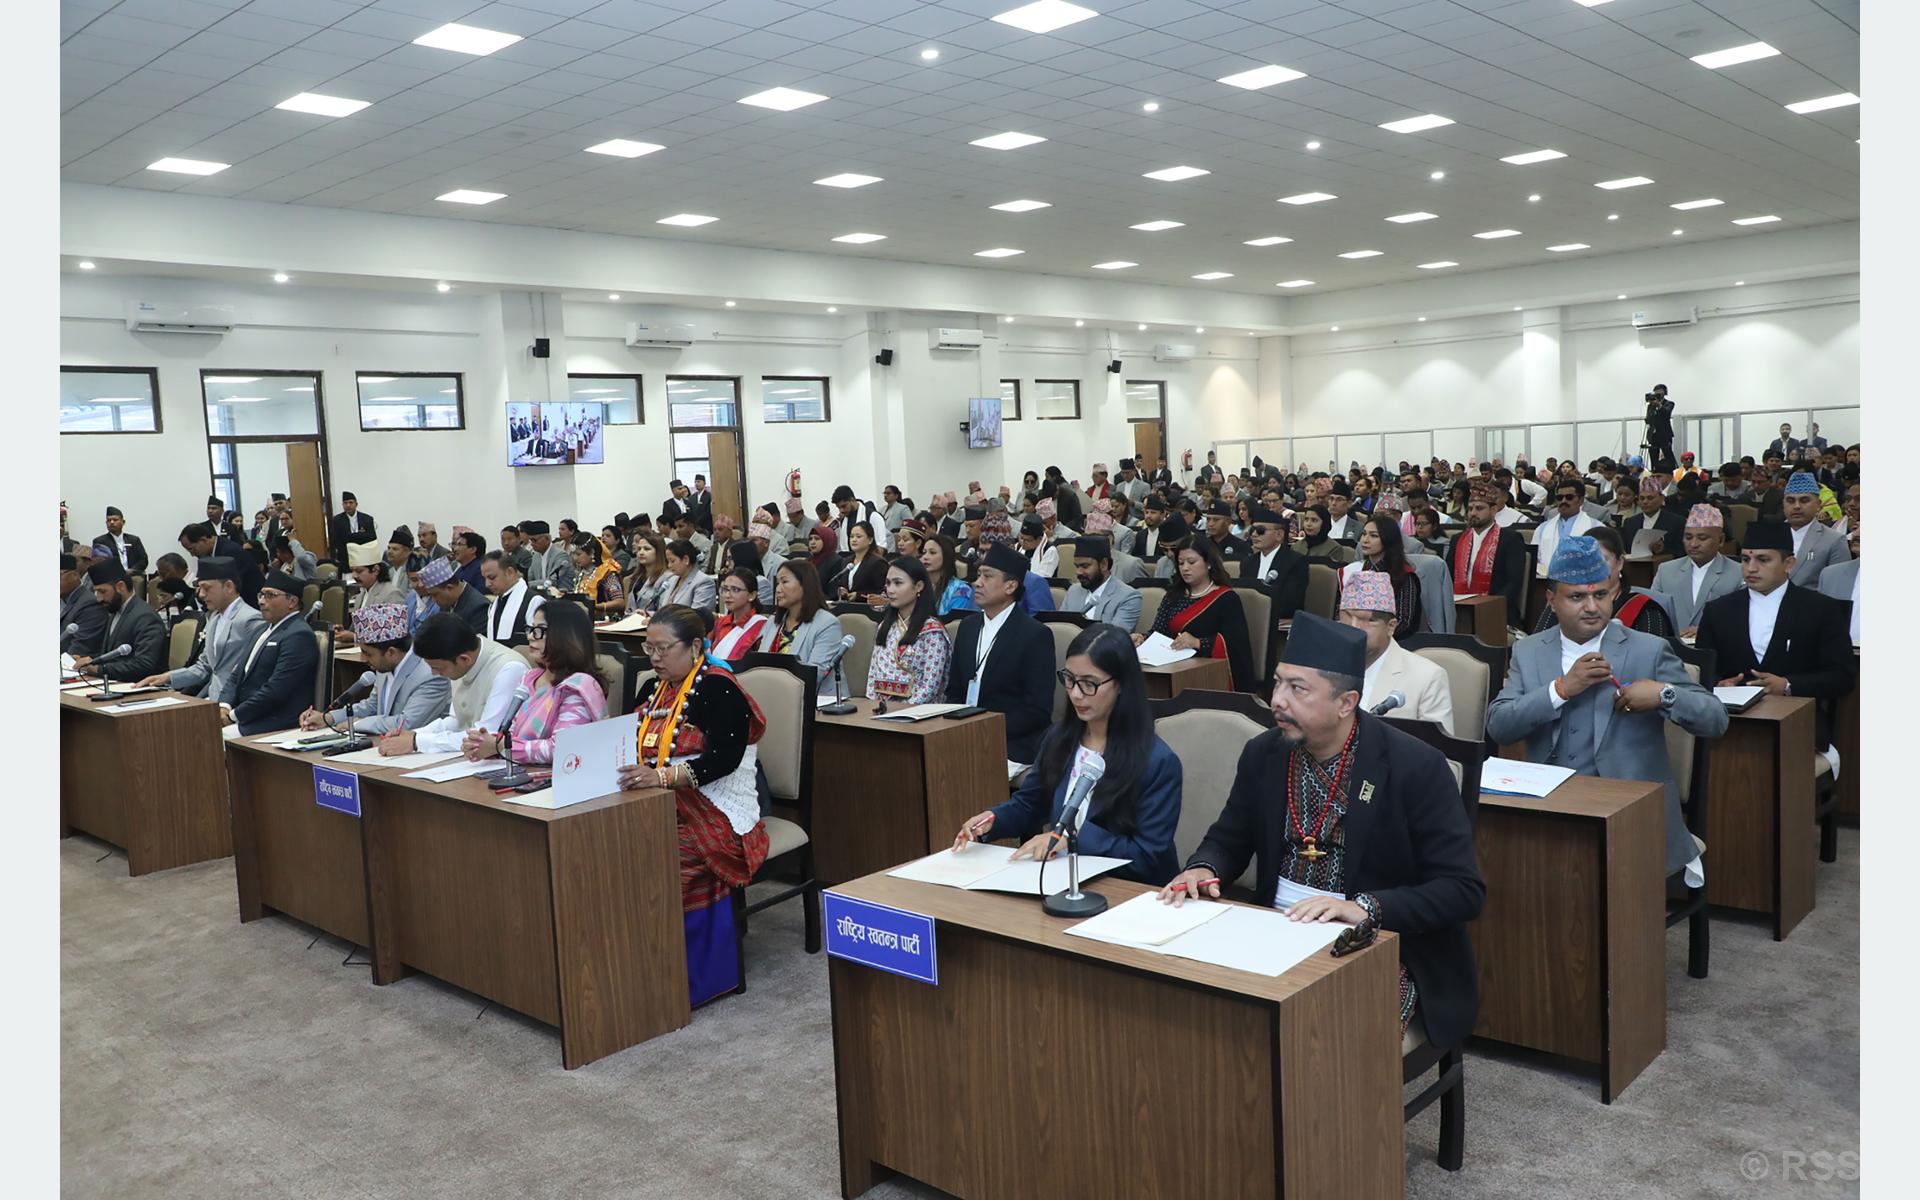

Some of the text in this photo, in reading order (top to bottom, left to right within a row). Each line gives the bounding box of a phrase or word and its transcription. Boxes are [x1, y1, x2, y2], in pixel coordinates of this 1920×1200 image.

[836, 916, 920, 955] राष्ट्रिय स्वतन्त्र पार्टी
